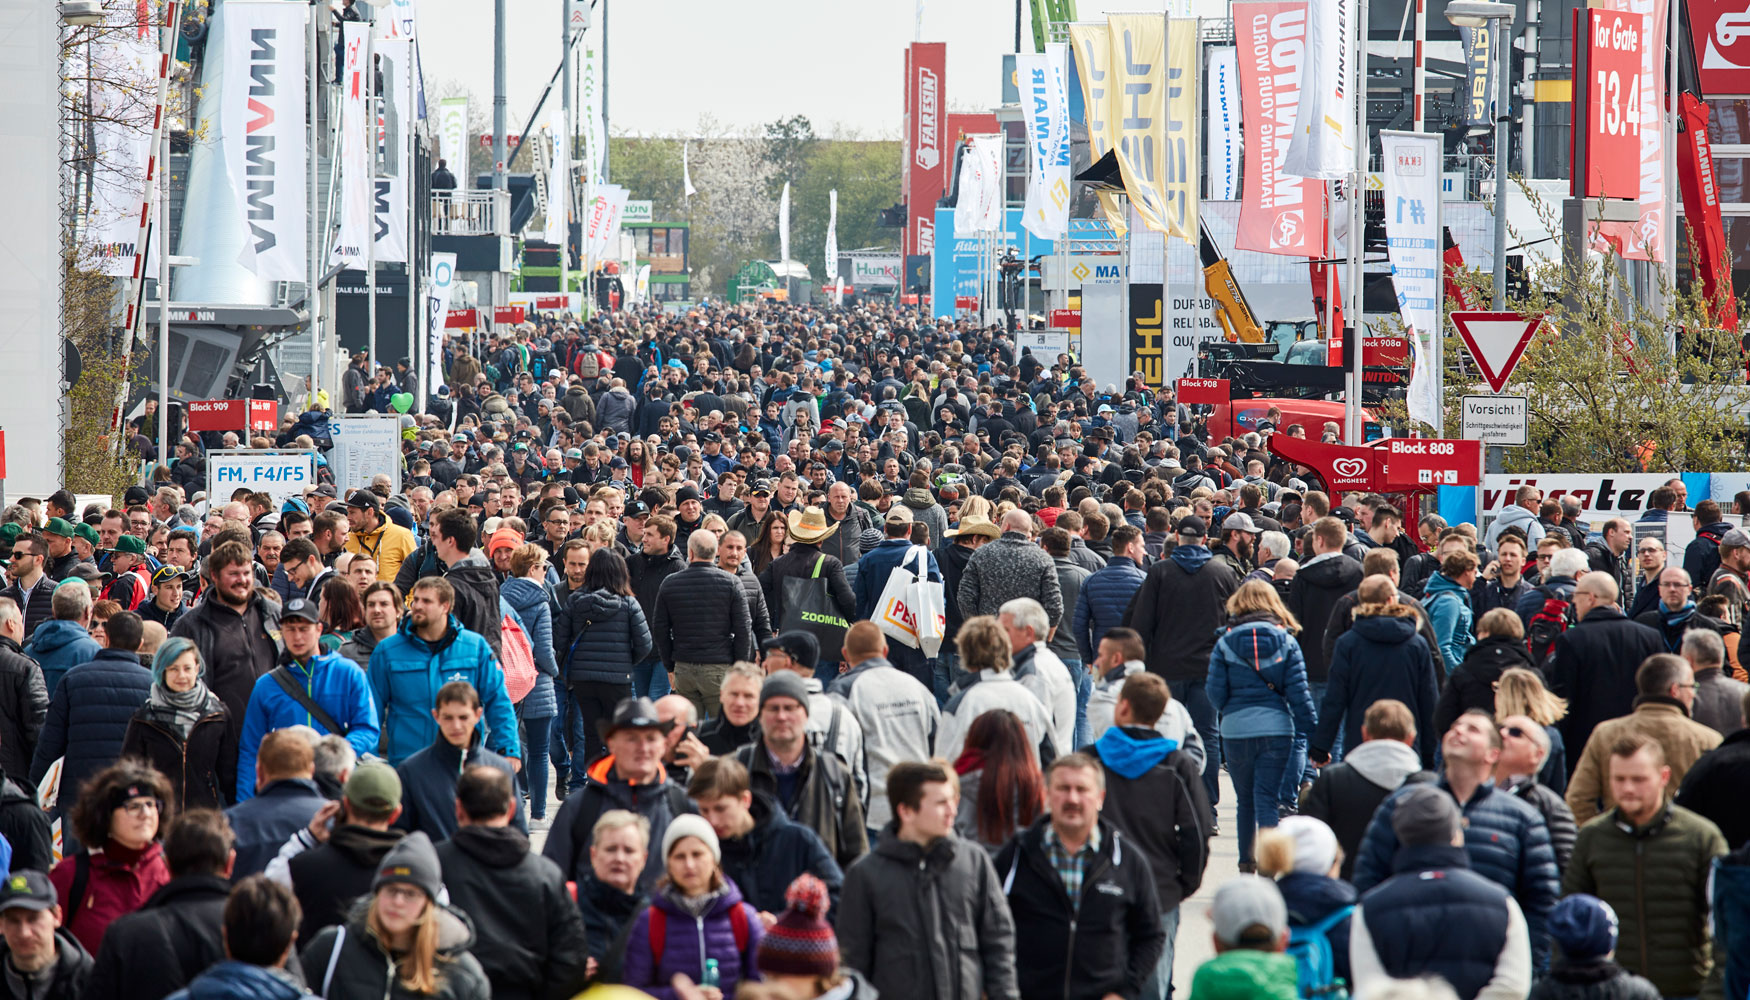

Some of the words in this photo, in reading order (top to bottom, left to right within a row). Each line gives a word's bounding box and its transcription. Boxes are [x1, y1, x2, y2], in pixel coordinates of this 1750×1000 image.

[1594, 14, 1610, 48] Tor
[1613, 16, 1637, 52] Gate
[1597, 70, 1640, 136] 13.4
[921, 77, 936, 146] FARESIN
[1695, 129, 1716, 207] MANITOU
[158, 311, 215, 321] MMANN
[1362, 339, 1378, 347] lock
[1380, 339, 1401, 347] 908a
[1362, 371, 1400, 383] ANITOU
[1181, 380, 1201, 388] Block
[1203, 380, 1218, 388] 908
[190, 403, 211, 411] Block
[213, 402, 229, 411] 909
[251, 402, 262, 410] Block
[262, 402, 270, 410] 909
[1469, 404, 1514, 415] Vorsicht
[1466, 422, 1523, 431] Schrittgeschwindigkeit
[1392, 441, 1426, 454] Block
[1429, 442, 1454, 455] 808
[218, 467, 247, 483] FM,
[254, 466, 304, 481] F4/F5
